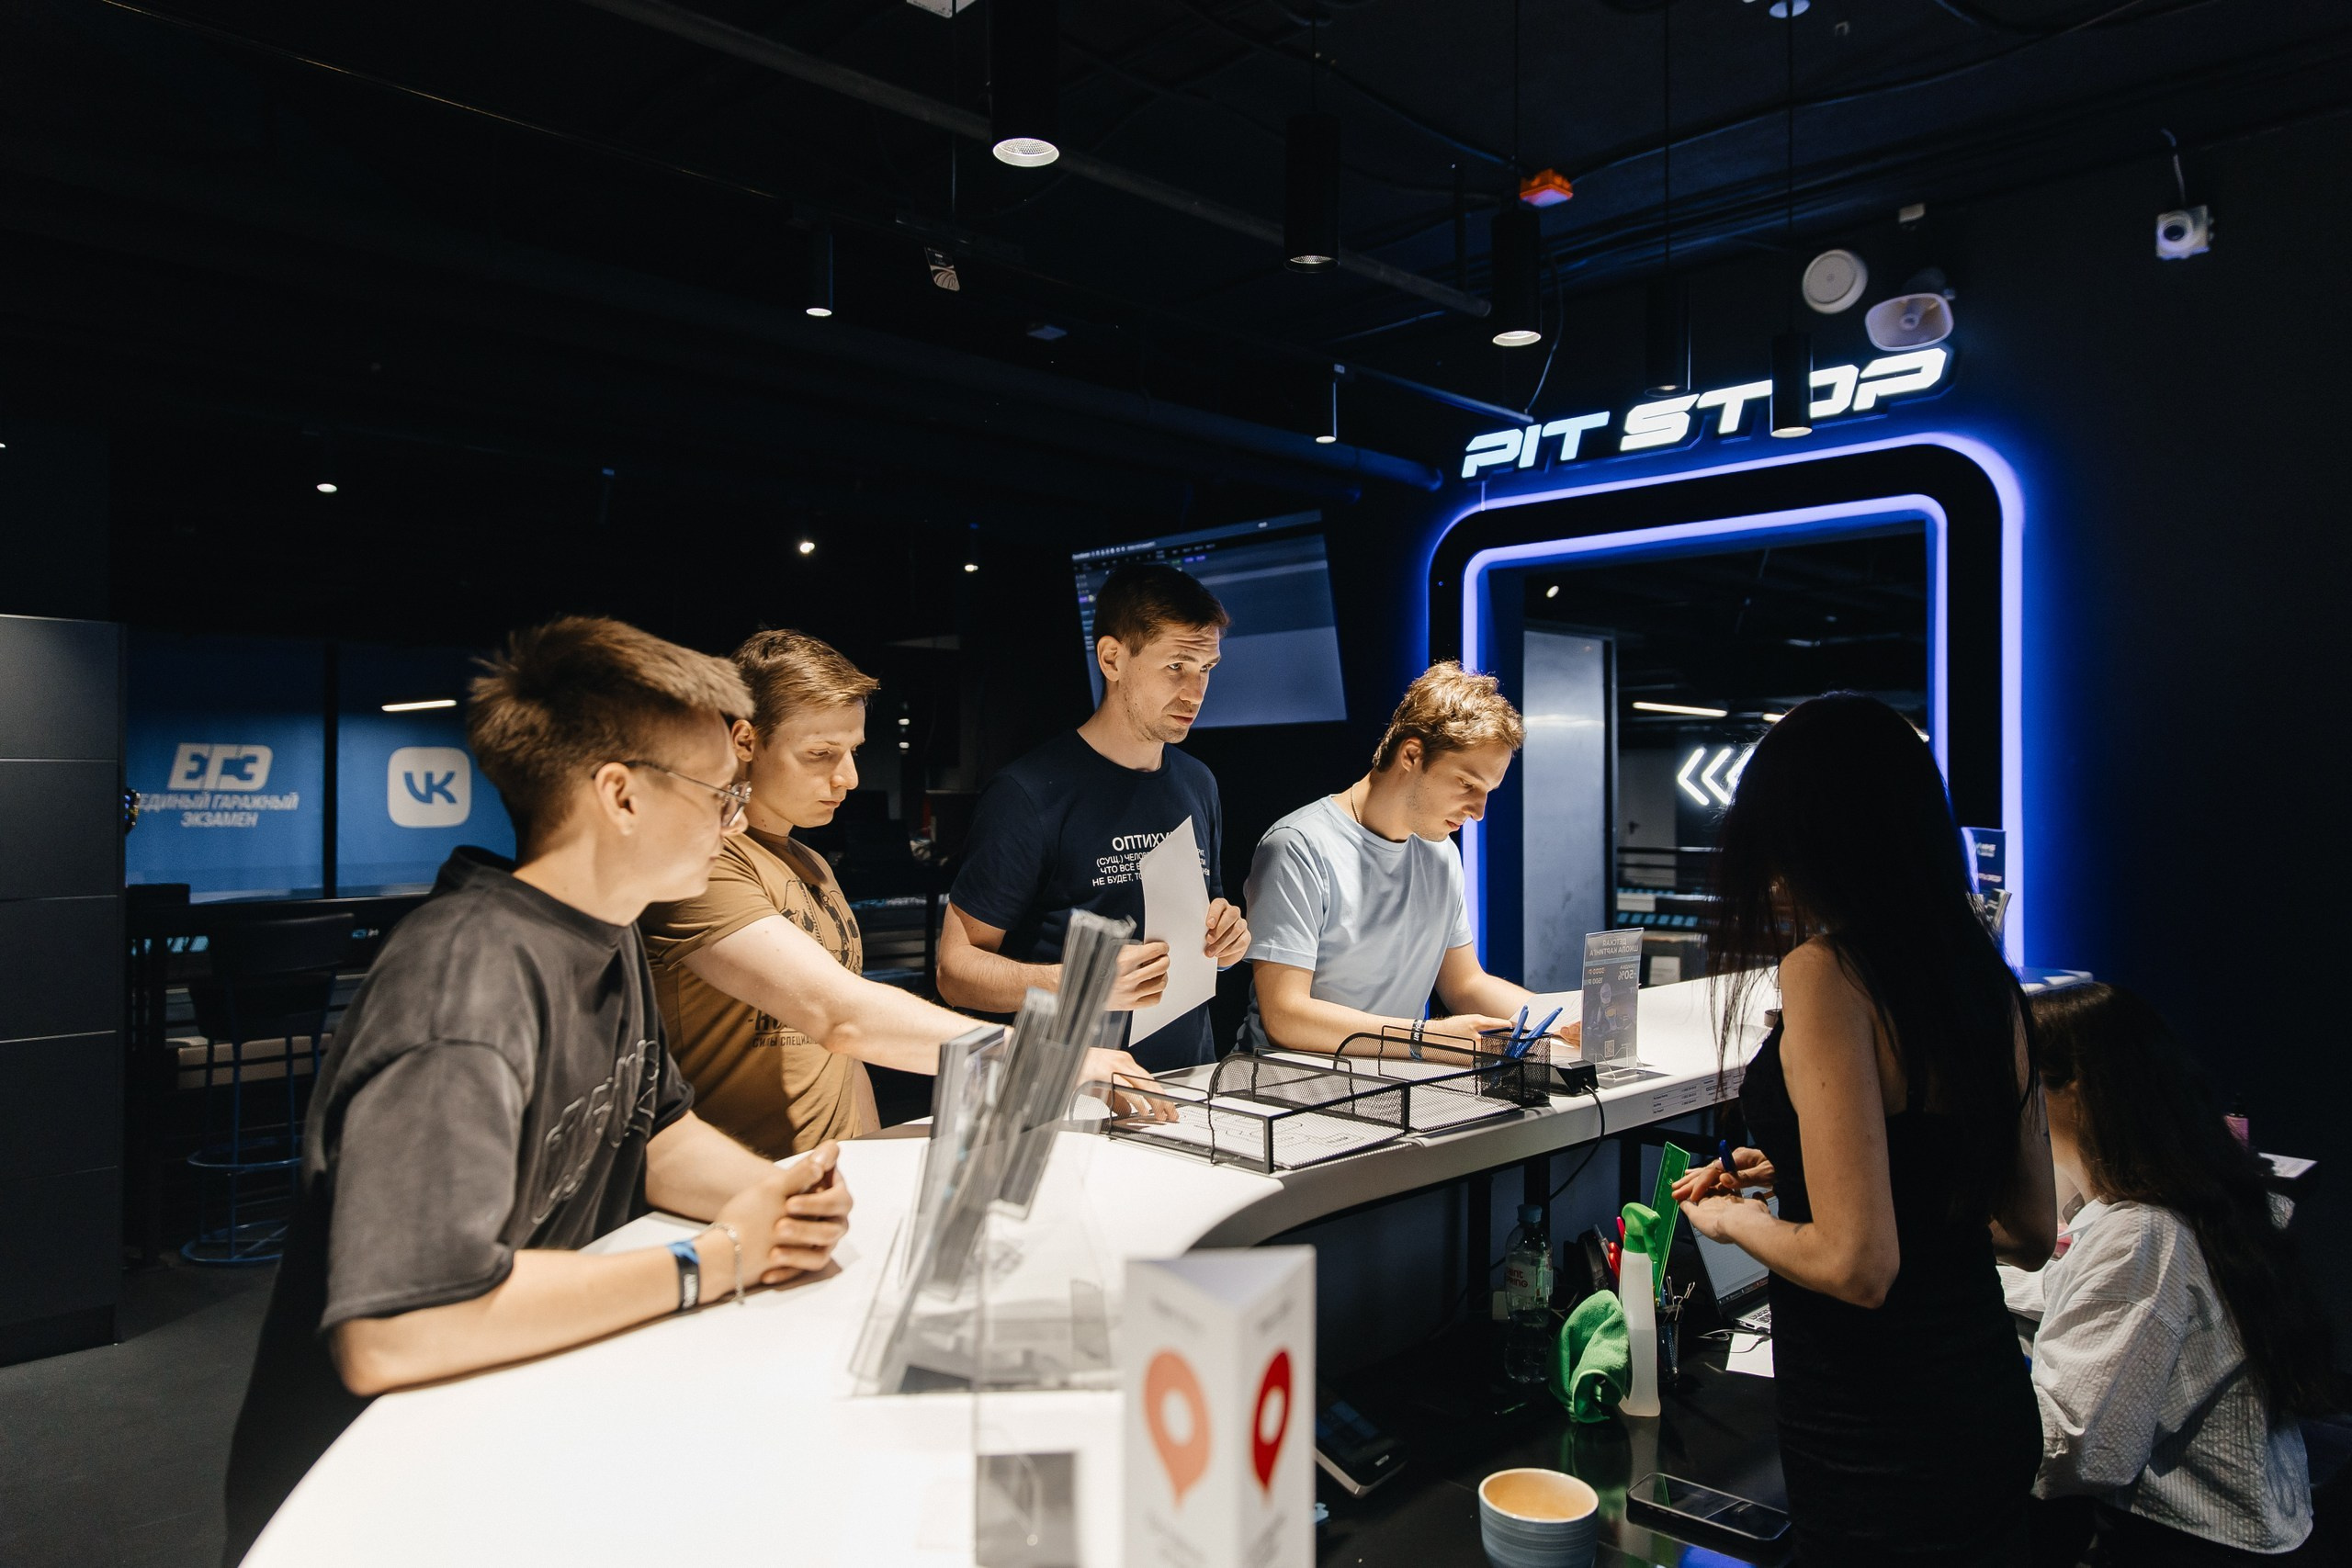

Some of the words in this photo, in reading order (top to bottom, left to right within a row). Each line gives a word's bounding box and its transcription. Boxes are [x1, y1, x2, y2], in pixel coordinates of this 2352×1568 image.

[1461, 412, 1610, 478] PIT
[404, 772, 457, 804] VK
[140, 791, 211, 812] ЕДИНЫЙ
[211, 792, 300, 810] ГАРАЖНЫЙ
[180, 812, 259, 828] ЭКЗАМЕН
[1112, 831, 1173, 851] ОПТИХУ
[1100, 865, 1118, 874] ЧТО
[1119, 863, 1136, 872] ВСЕ
[1091, 877, 1105, 886] НЕ
[1106, 874, 1134, 884] БУДЕТ,
